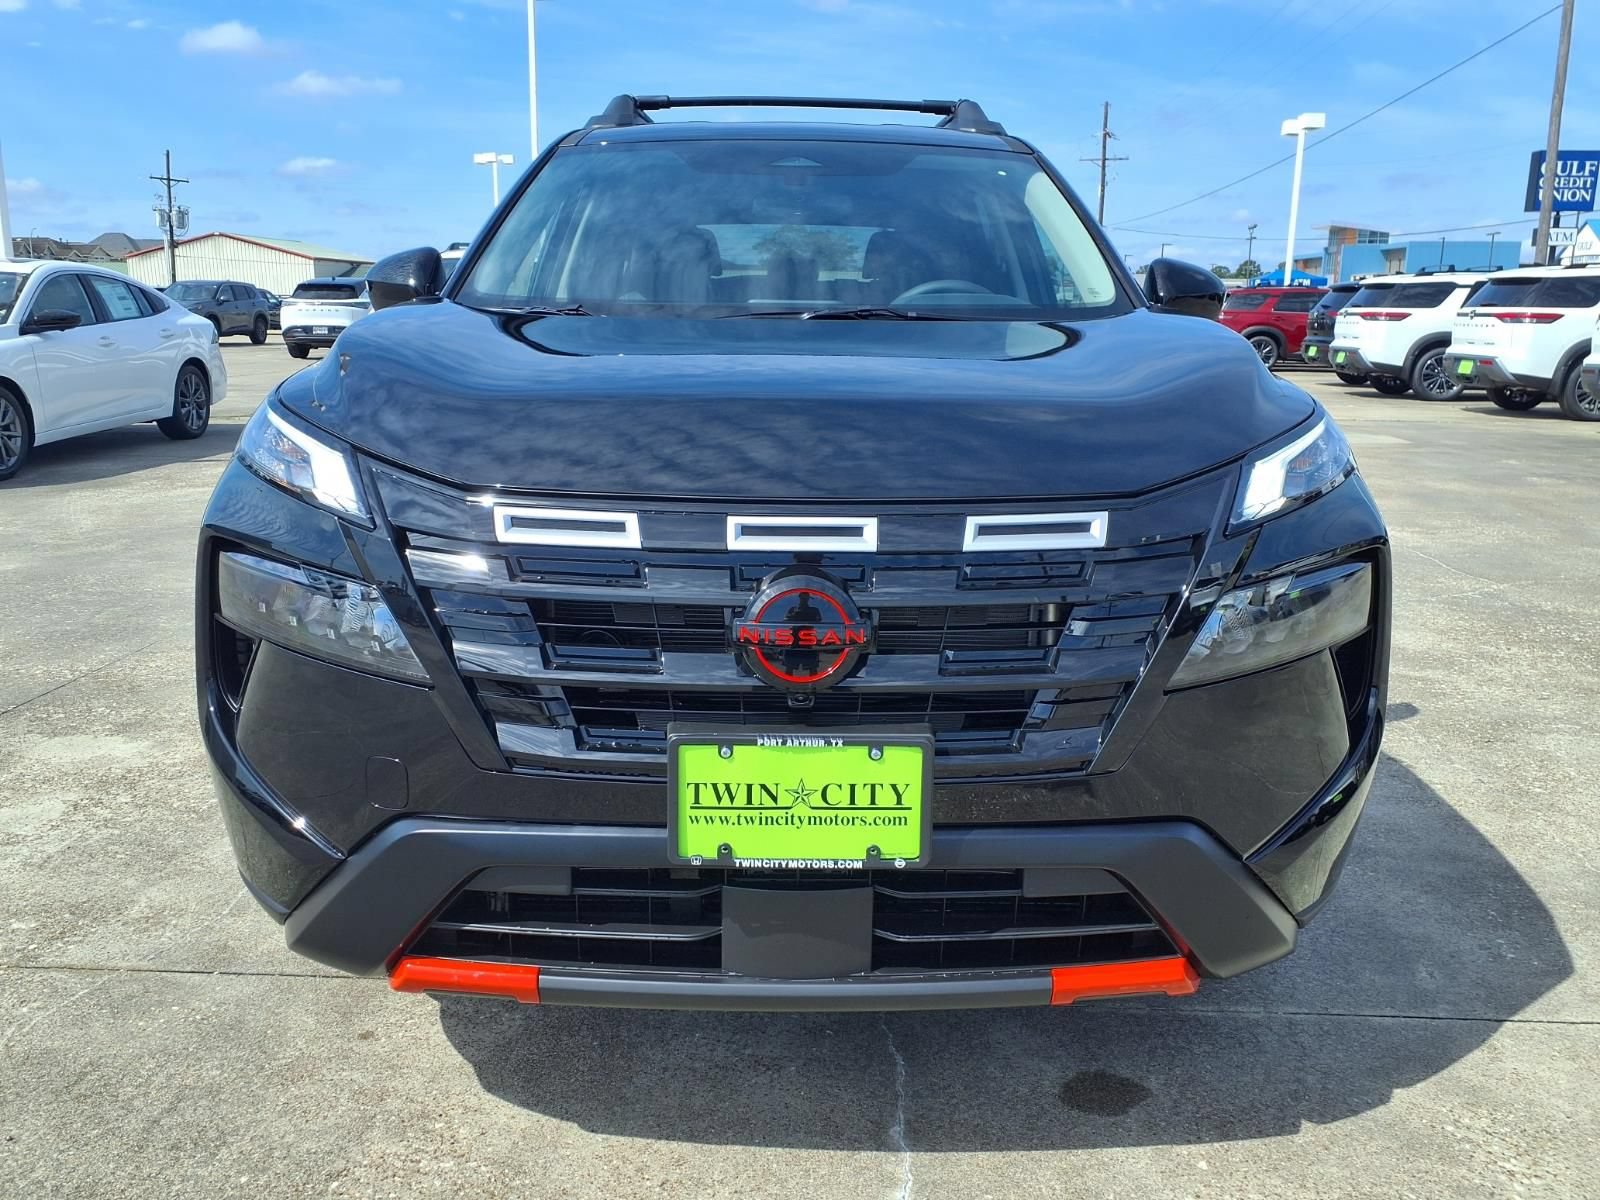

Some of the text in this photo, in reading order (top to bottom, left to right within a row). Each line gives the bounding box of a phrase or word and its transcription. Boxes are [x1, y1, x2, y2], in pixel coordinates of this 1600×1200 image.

[739, 626, 865, 645] NISSAN
[757, 736, 783, 747] PORT
[831, 737, 844, 747] TX
[687, 783, 910, 806] TWIN CITY
[689, 811, 908, 829] www.twincitymotors.com
[734, 858, 863, 869] TWINCITYMOTORS.COM
